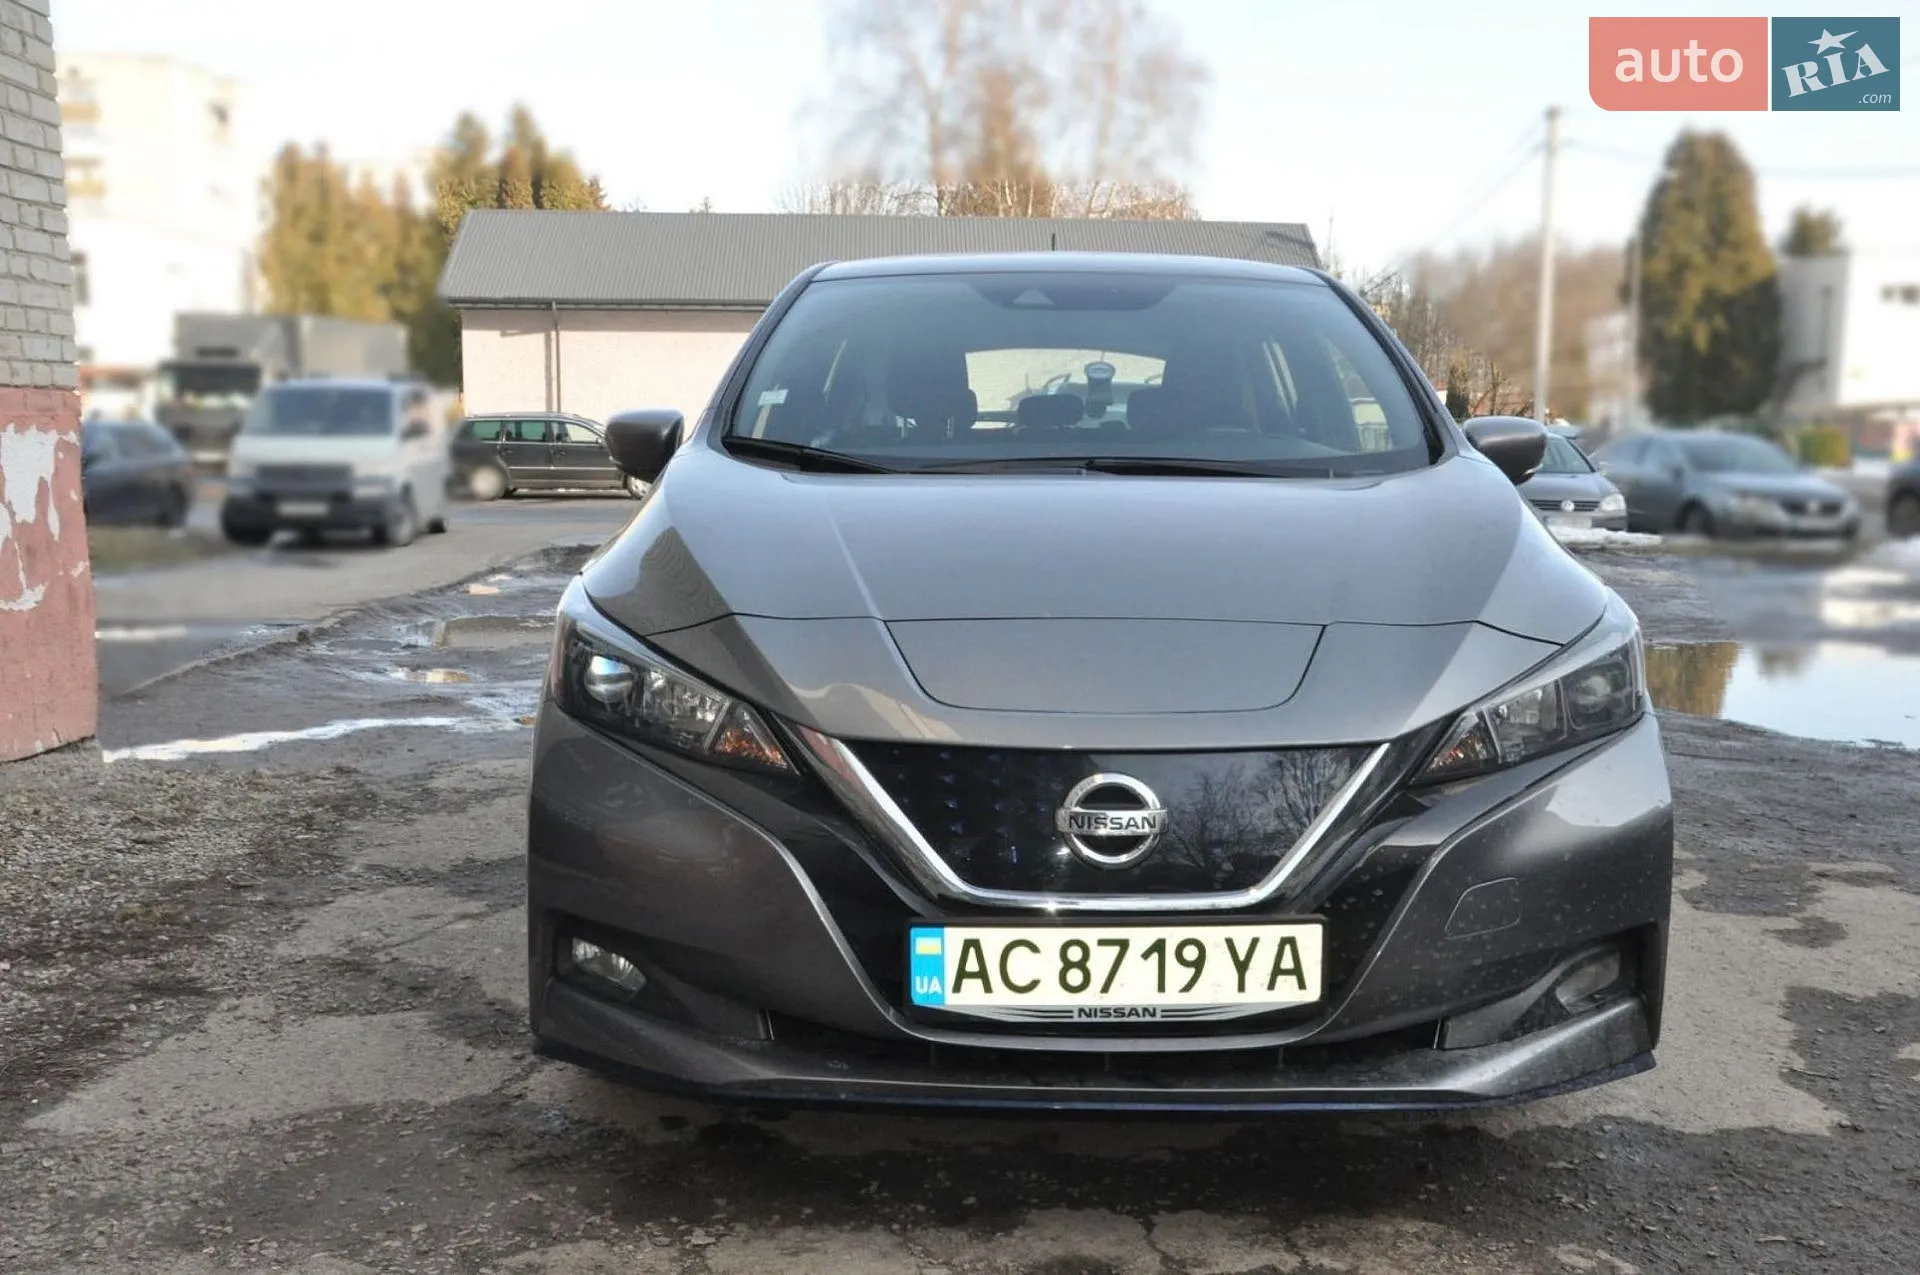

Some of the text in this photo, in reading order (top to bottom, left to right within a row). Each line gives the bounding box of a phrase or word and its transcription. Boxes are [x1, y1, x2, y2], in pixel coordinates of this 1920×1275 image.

[1068, 815, 1156, 830] NISSAN
[952, 936, 1307, 993] AC 8719 YA
[915, 979, 942, 994] UA
[1077, 1006, 1157, 1019] NISSAN
